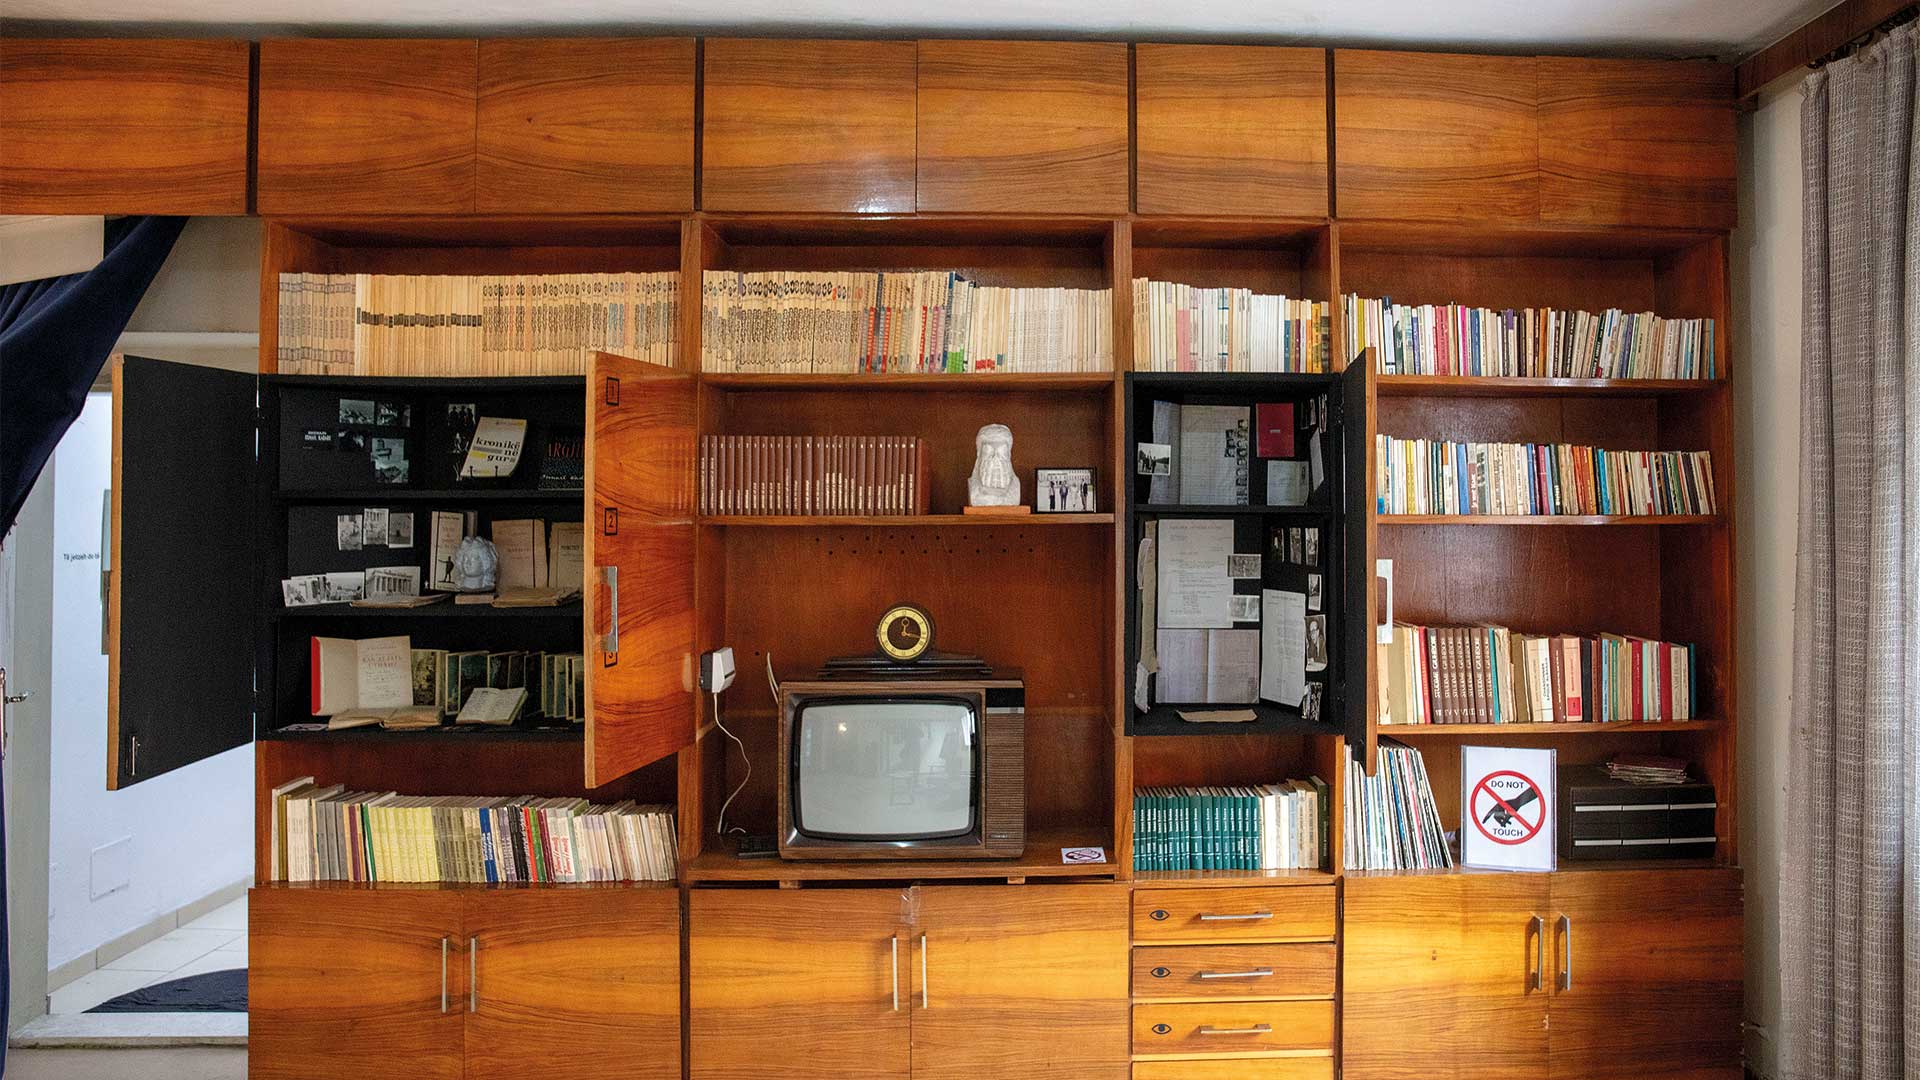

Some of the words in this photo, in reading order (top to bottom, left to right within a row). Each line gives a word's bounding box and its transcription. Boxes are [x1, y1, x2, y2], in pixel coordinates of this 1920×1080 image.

[476, 437, 521, 450] kronikë
[487, 454, 510, 462] gur
[608, 515, 614, 528] 2
[1491, 780, 1504, 789] DO
[1506, 781, 1523, 789] NOT
[1493, 828, 1522, 837] TOUCH
